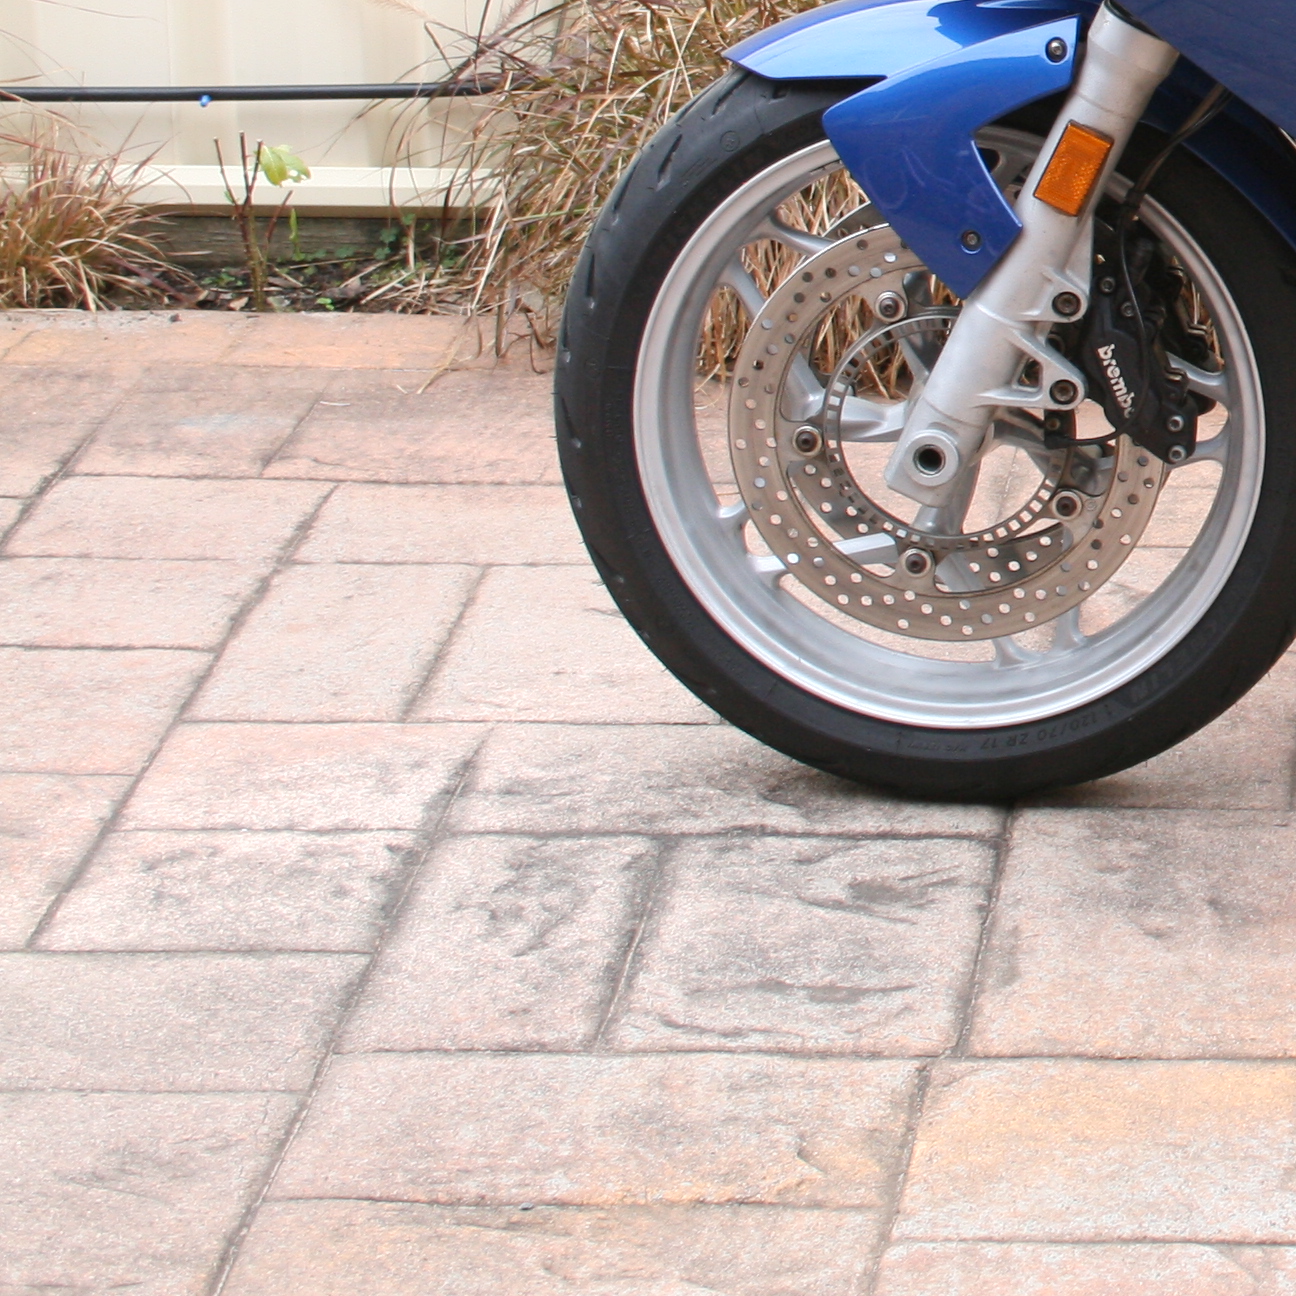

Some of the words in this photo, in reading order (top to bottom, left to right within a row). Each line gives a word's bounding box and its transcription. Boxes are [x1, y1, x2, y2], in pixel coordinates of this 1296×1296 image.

[1037, 711, 1098, 741] 120/70
[980, 737, 998, 750] 17
[1006, 733, 1029, 748] ZR
